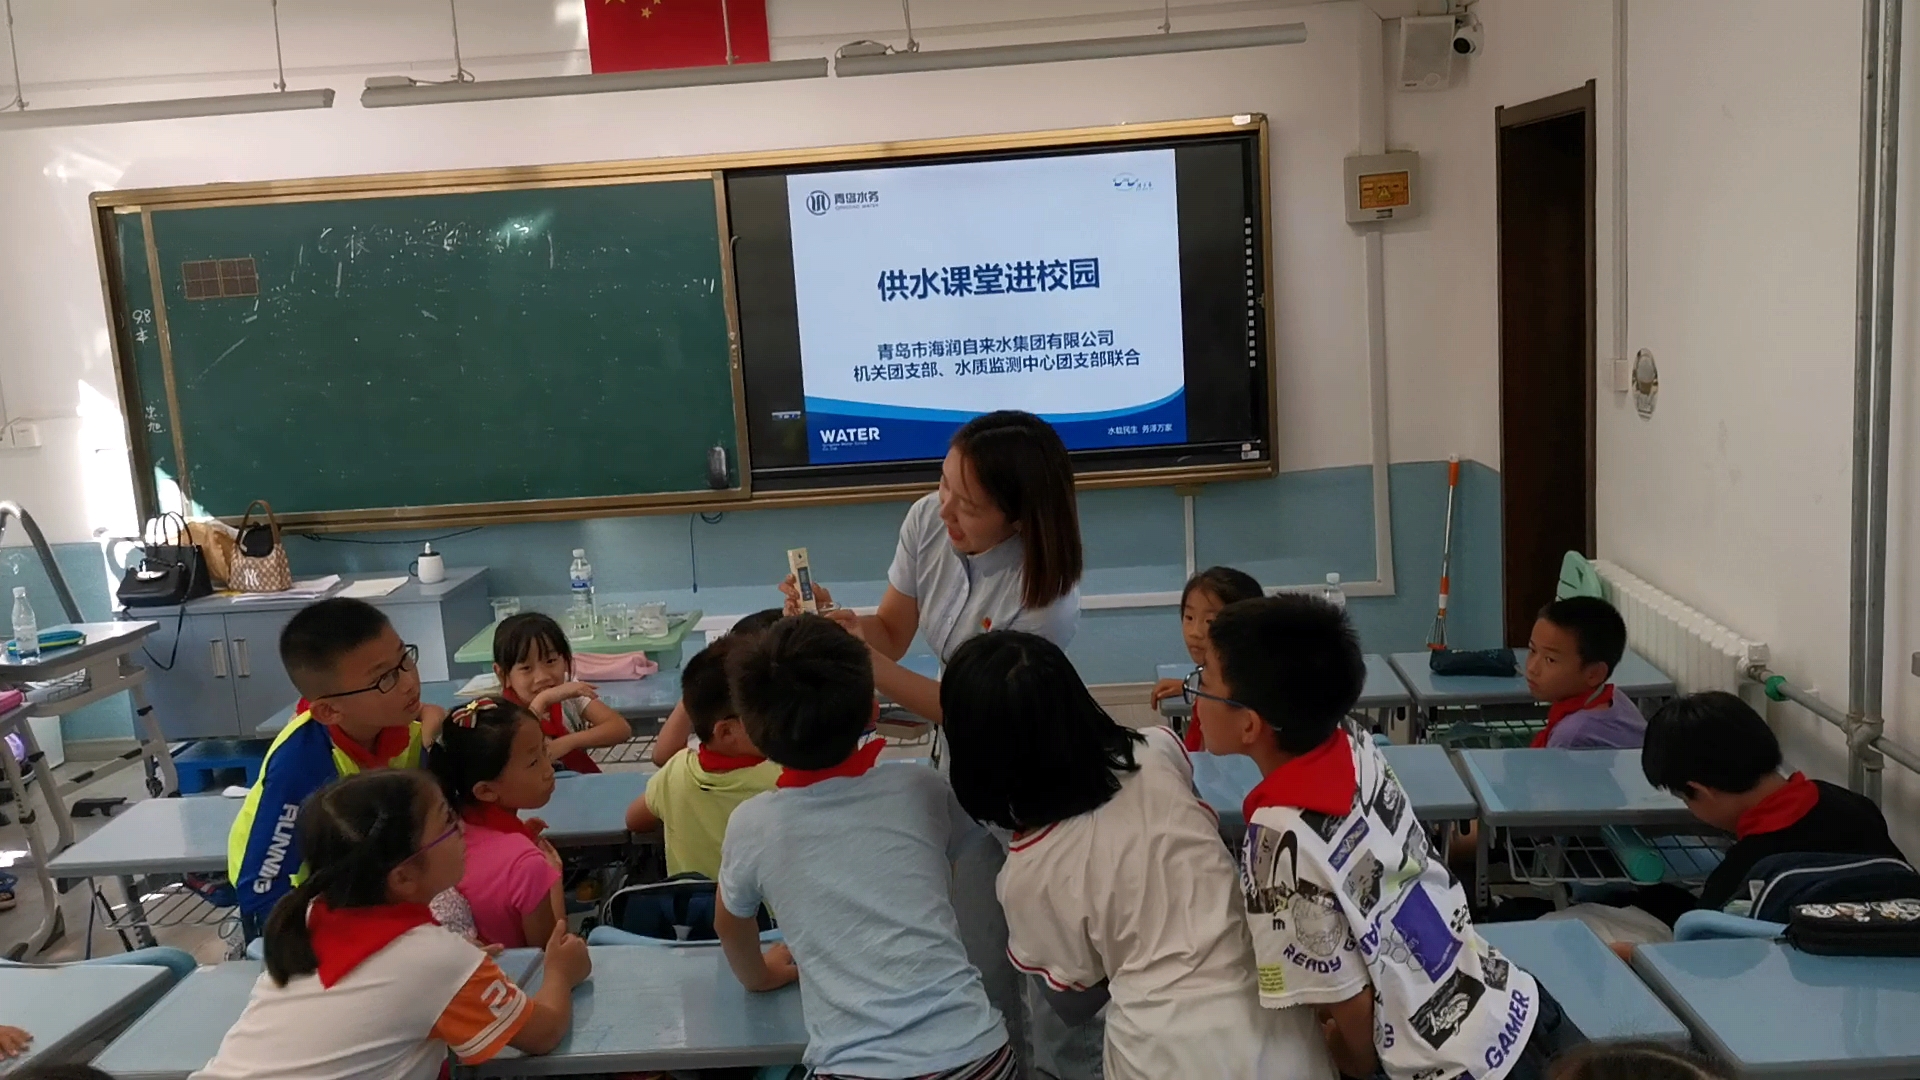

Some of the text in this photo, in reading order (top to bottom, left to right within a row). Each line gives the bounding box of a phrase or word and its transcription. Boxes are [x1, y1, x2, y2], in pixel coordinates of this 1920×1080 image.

[877, 257, 1100, 302] 供水课堂进校园
[877, 329, 1115, 361] 青岛市海润自来水集团有限公司
[853, 348, 1140, 382] 机关团支部、水质监测中心团支部联合
[819, 426, 881, 444] WATER
[253, 803, 299, 893] RUNNING
[1283, 943, 1342, 974] READY
[1485, 989, 1530, 1070] GAMER
